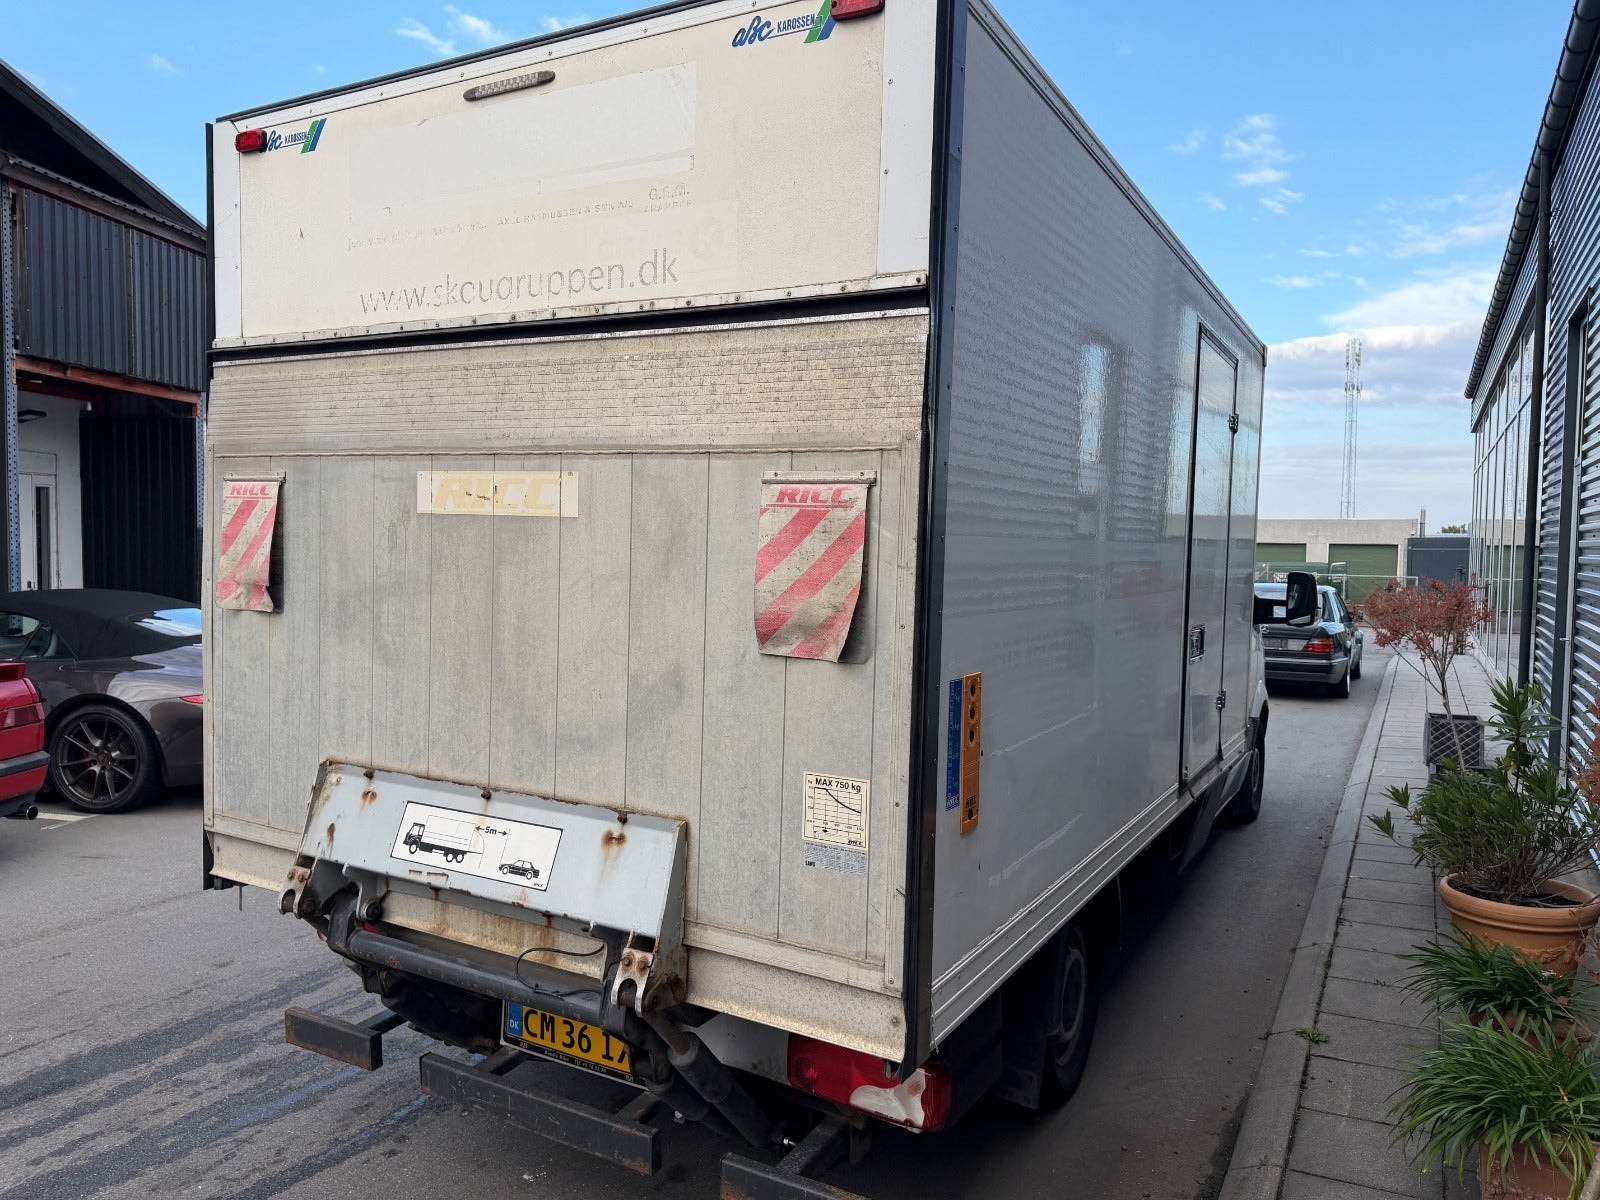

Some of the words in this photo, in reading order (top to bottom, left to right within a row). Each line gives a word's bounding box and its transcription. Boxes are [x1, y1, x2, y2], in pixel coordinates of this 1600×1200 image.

[777, 13, 815, 32] KAROSSEN
[815, 777, 833, 788] MAX
[835, 780, 850, 790] 750
[851, 783, 861, 793] kg
[484, 826, 497, 835] 5m
[509, 1020, 519, 1029] DK
[524, 1010, 555, 1043] CM
[562, 1020, 591, 1053] 36
